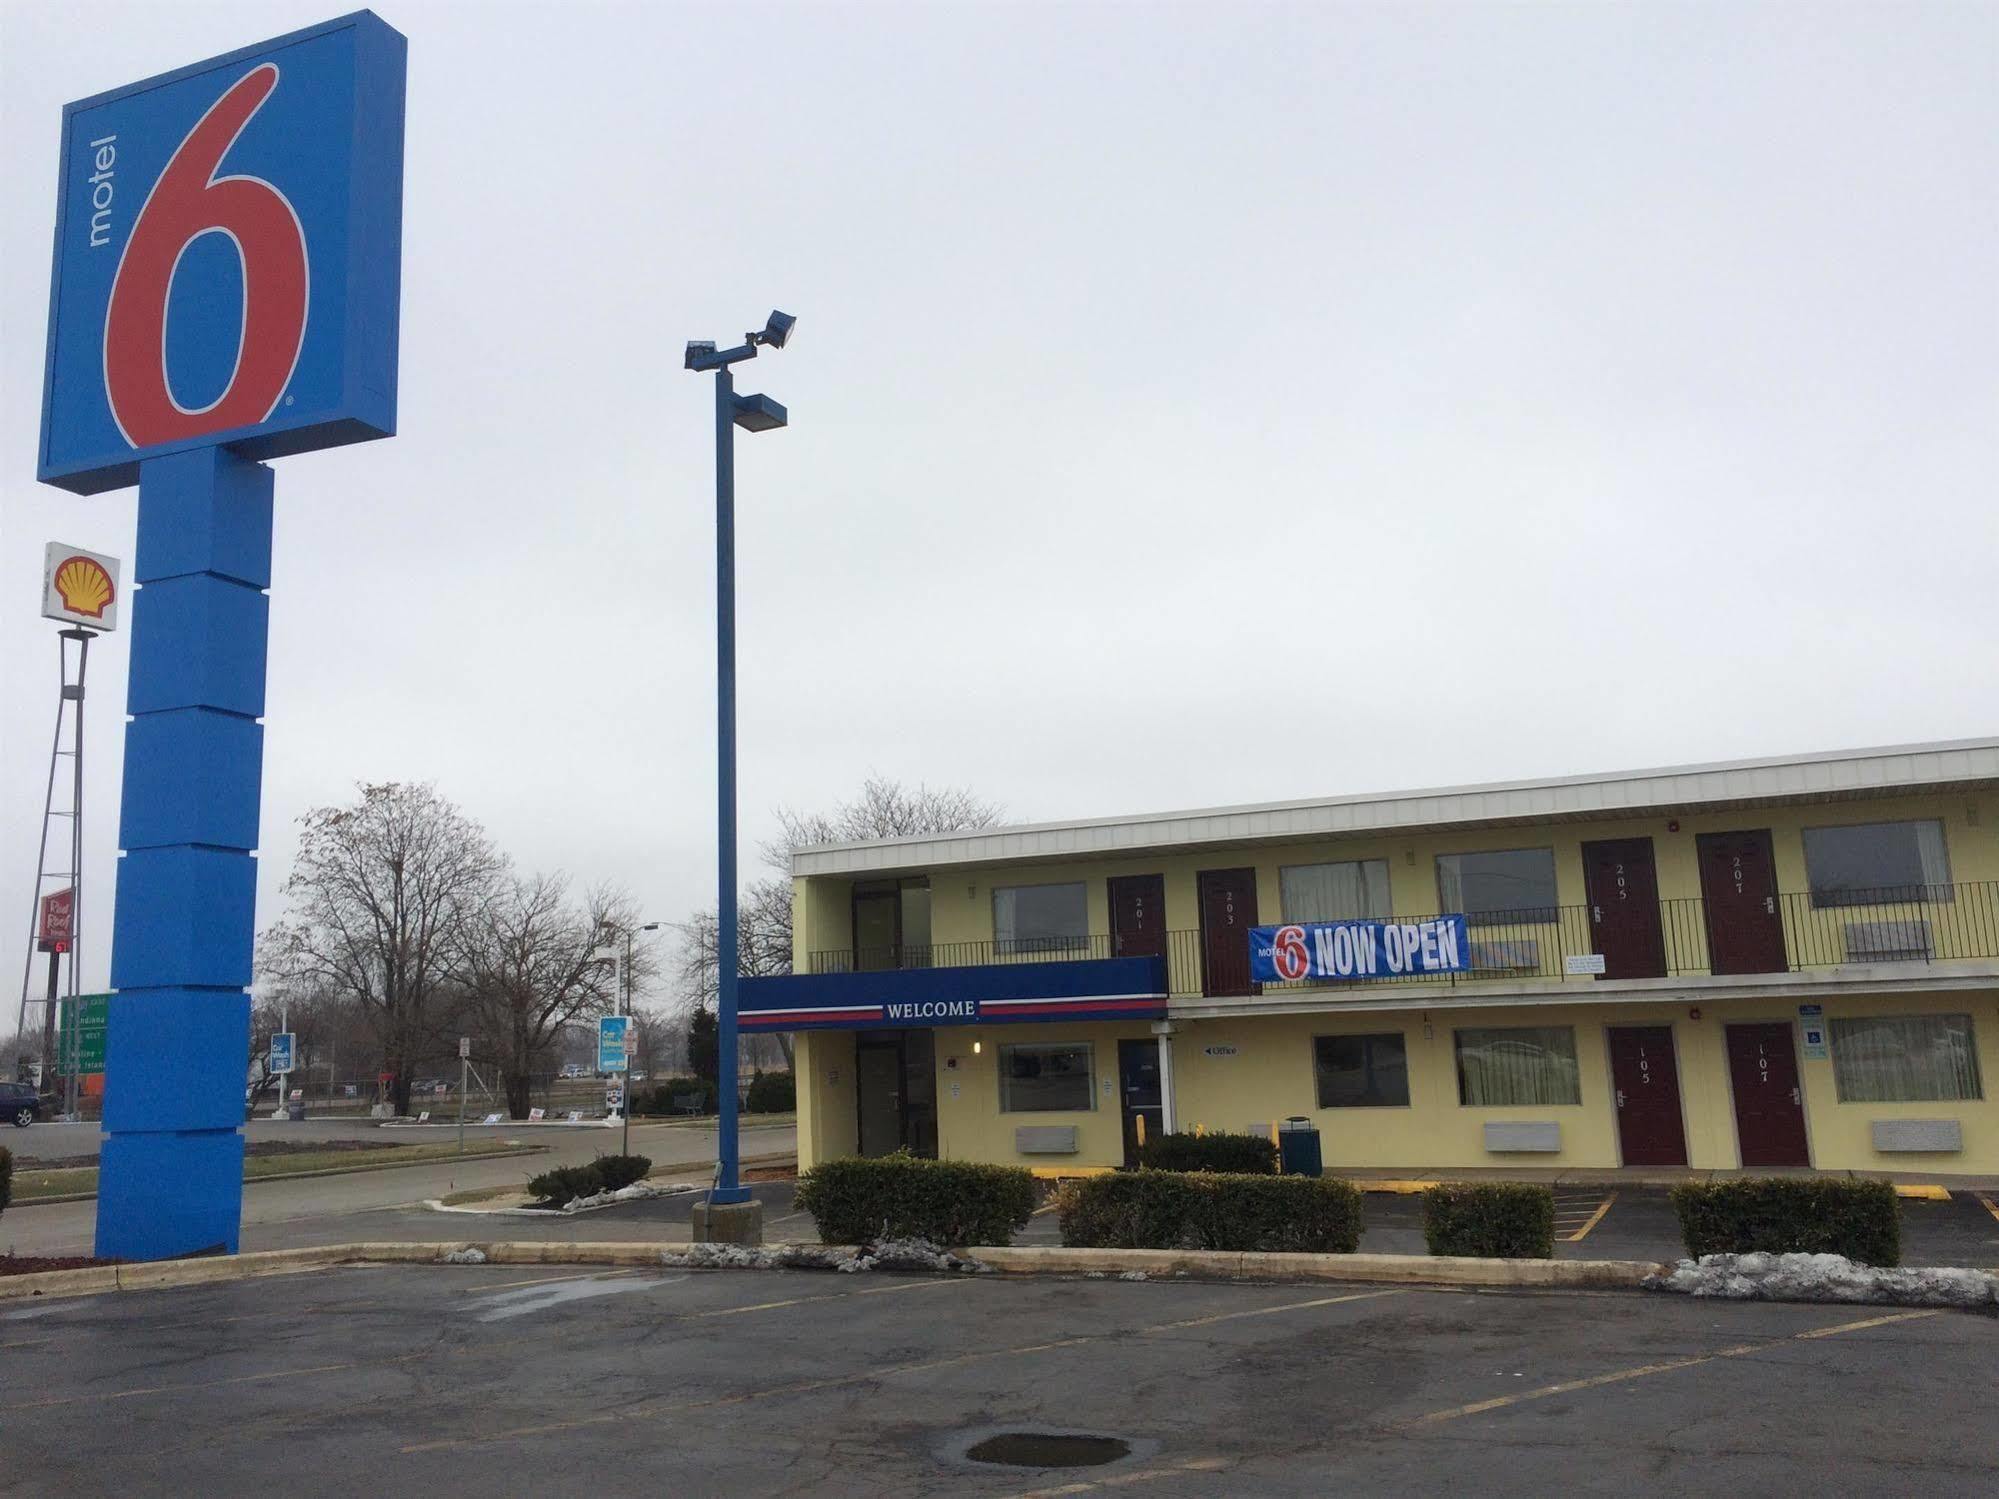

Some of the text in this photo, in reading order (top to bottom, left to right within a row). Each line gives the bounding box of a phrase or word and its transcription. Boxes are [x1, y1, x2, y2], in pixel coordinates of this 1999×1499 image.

[90, 135, 117, 247] motel
[103, 62, 310, 449] 6
[1616, 864, 1627, 900] 205
[1733, 857, 1743, 894] 207
[1258, 920, 1460, 981] MOTEL 6 NOW OPEN
[887, 1000, 976, 1019] WELCOME
[1640, 1047, 1650, 1084] 105
[1759, 1044, 1768, 1083] 107
